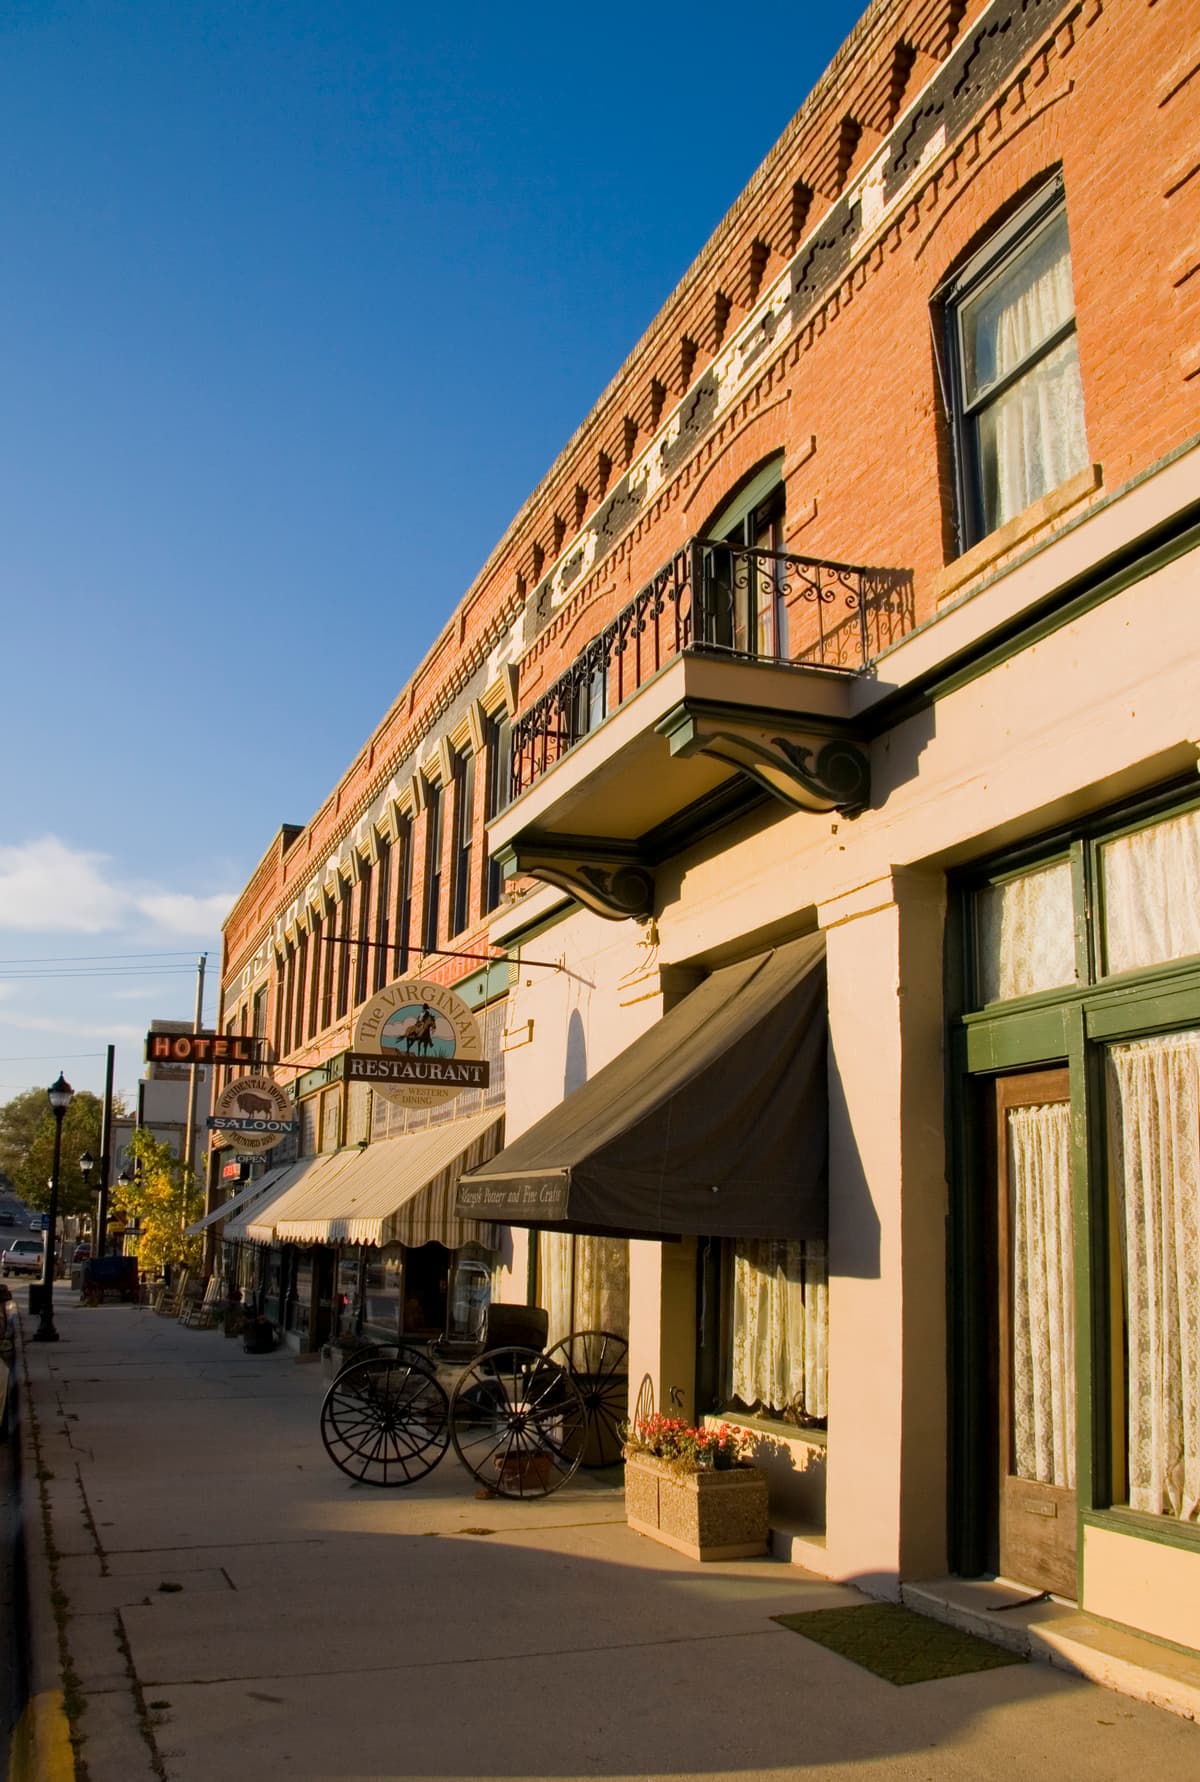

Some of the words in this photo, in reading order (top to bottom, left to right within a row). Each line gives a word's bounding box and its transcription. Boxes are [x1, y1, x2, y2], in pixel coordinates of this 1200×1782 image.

[485, 122, 946, 693] HOTEL
[360, 1007, 385, 1041] The
[382, 984, 477, 1049] VIRGINIAN
[155, 1036, 249, 1059] HOTEL
[350, 1058, 484, 1082] RESTAURANT
[221, 1079, 267, 1109] OCCIDENTAL
[267, 1085, 287, 1112] HOTEL
[402, 1095, 433, 1105] DINING
[408, 1087, 449, 1097] WESTERN
[214, 1118, 293, 1132] SALOON
[229, 1131, 261, 1148] FOUNDED
[237, 1154, 267, 1163] OPEN
[507, 1184, 521, 1203] and
[522, 1183, 538, 1203] Fine
[539, 1183, 562, 1203] Crafts
